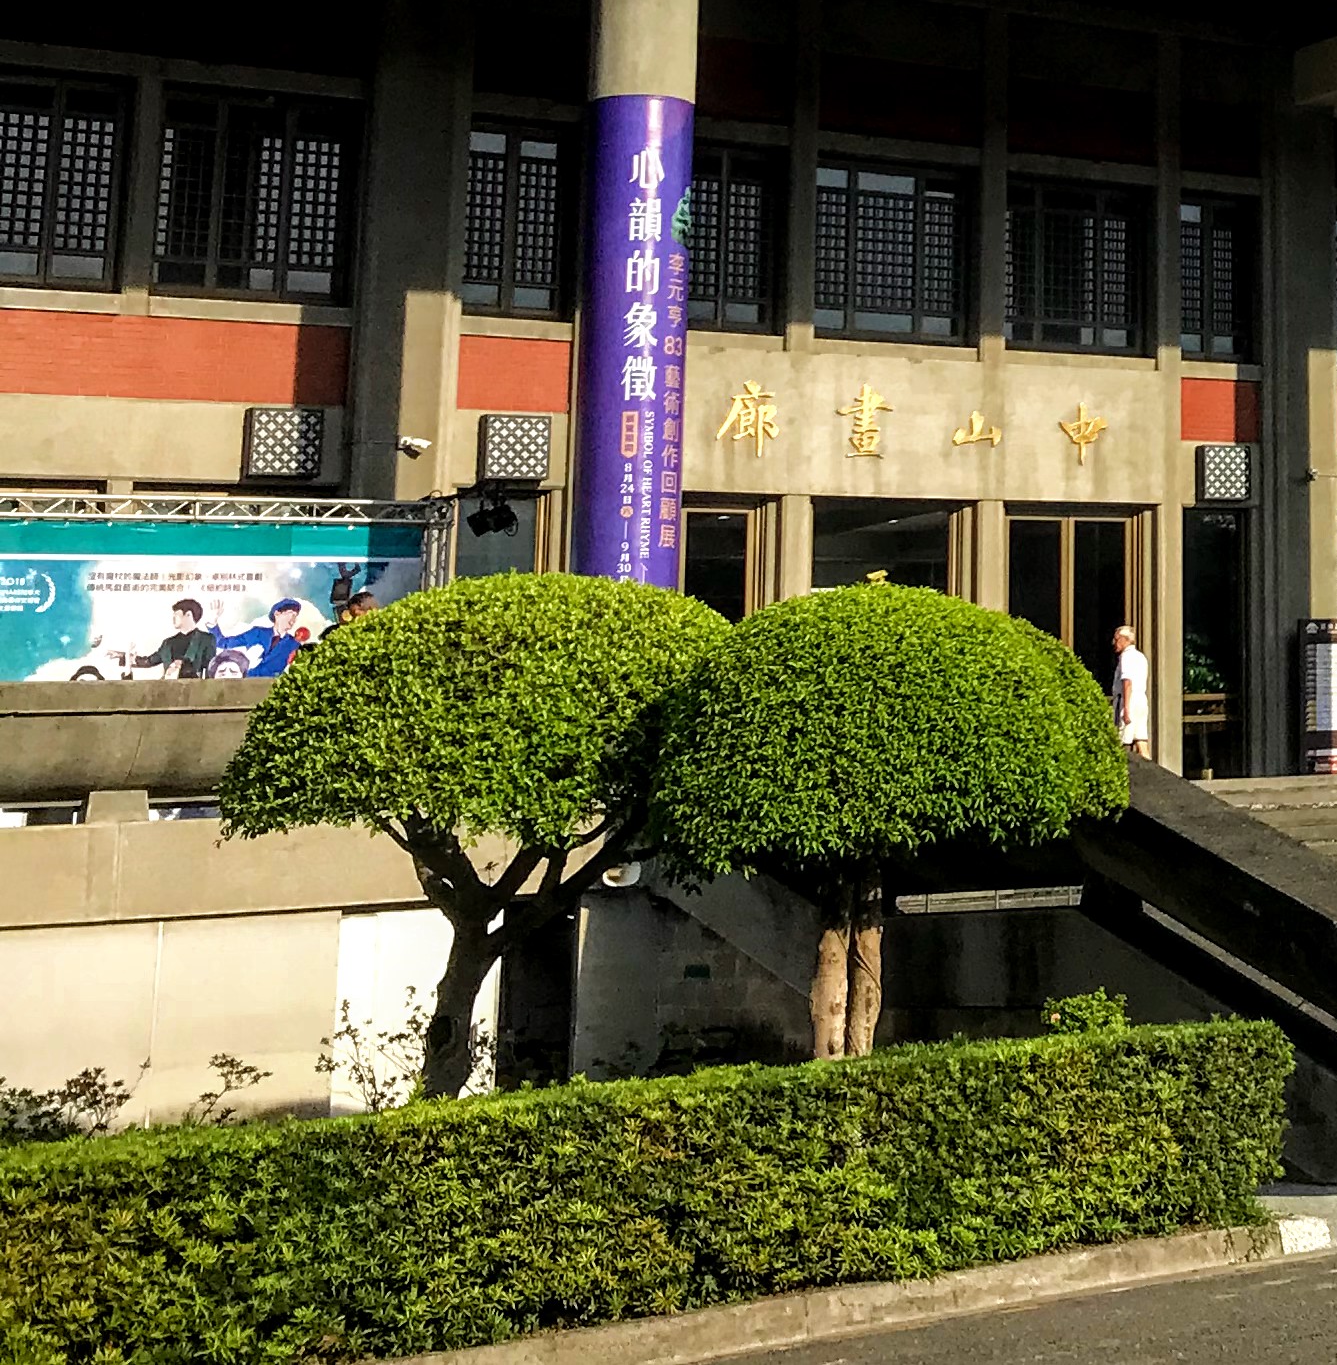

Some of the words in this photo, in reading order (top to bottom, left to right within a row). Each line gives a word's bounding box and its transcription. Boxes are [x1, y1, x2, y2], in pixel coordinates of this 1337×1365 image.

[621, 146, 665, 401] 心韻的象徵
[664, 335, 683, 357] 83
[643, 411, 655, 458] SYMBOL
[641, 460, 653, 476] OF
[640, 477, 653, 515] HEART
[639, 517, 651, 559] RHYME
